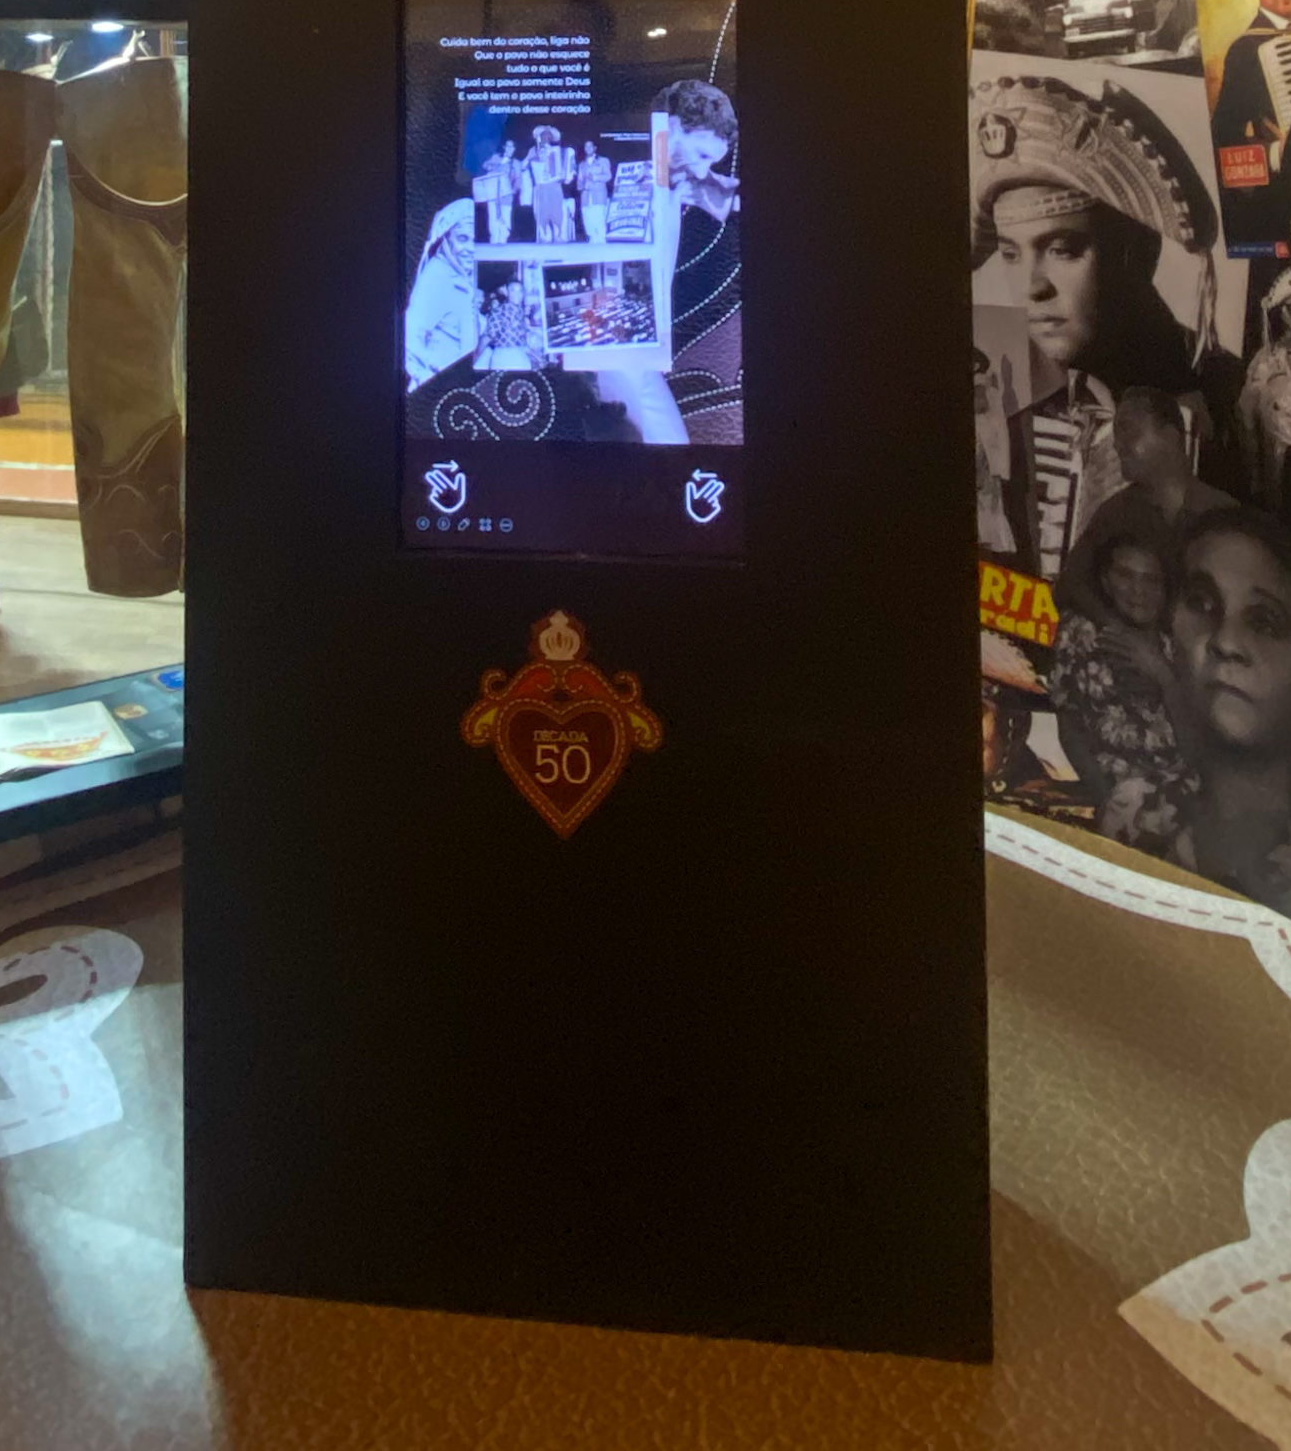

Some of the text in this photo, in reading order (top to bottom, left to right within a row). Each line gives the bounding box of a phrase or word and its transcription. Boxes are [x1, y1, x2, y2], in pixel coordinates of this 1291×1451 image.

[470, 38, 491, 46] bem
[474, 51, 494, 60] Que
[504, 52, 528, 60] povo
[550, 51, 590, 60] esquece
[506, 64, 529, 73] tudo
[539, 65, 558, 74] que
[560, 63, 582, 72] você
[454, 78, 481, 88] Igual
[497, 80, 520, 88] povo
[522, 78, 563, 86] somente
[565, 77, 590, 86] Deus
[467, 92, 488, 100] você
[490, 92, 509, 100] tem
[520, 93, 543, 102] povo
[544, 90, 590, 99] inteirinho
[489, 105, 521, 114] dentro
[1227, 150, 1256, 164] LUIZ
[980, 566, 1059, 623] RTA
[535, 745, 590, 784] 50
